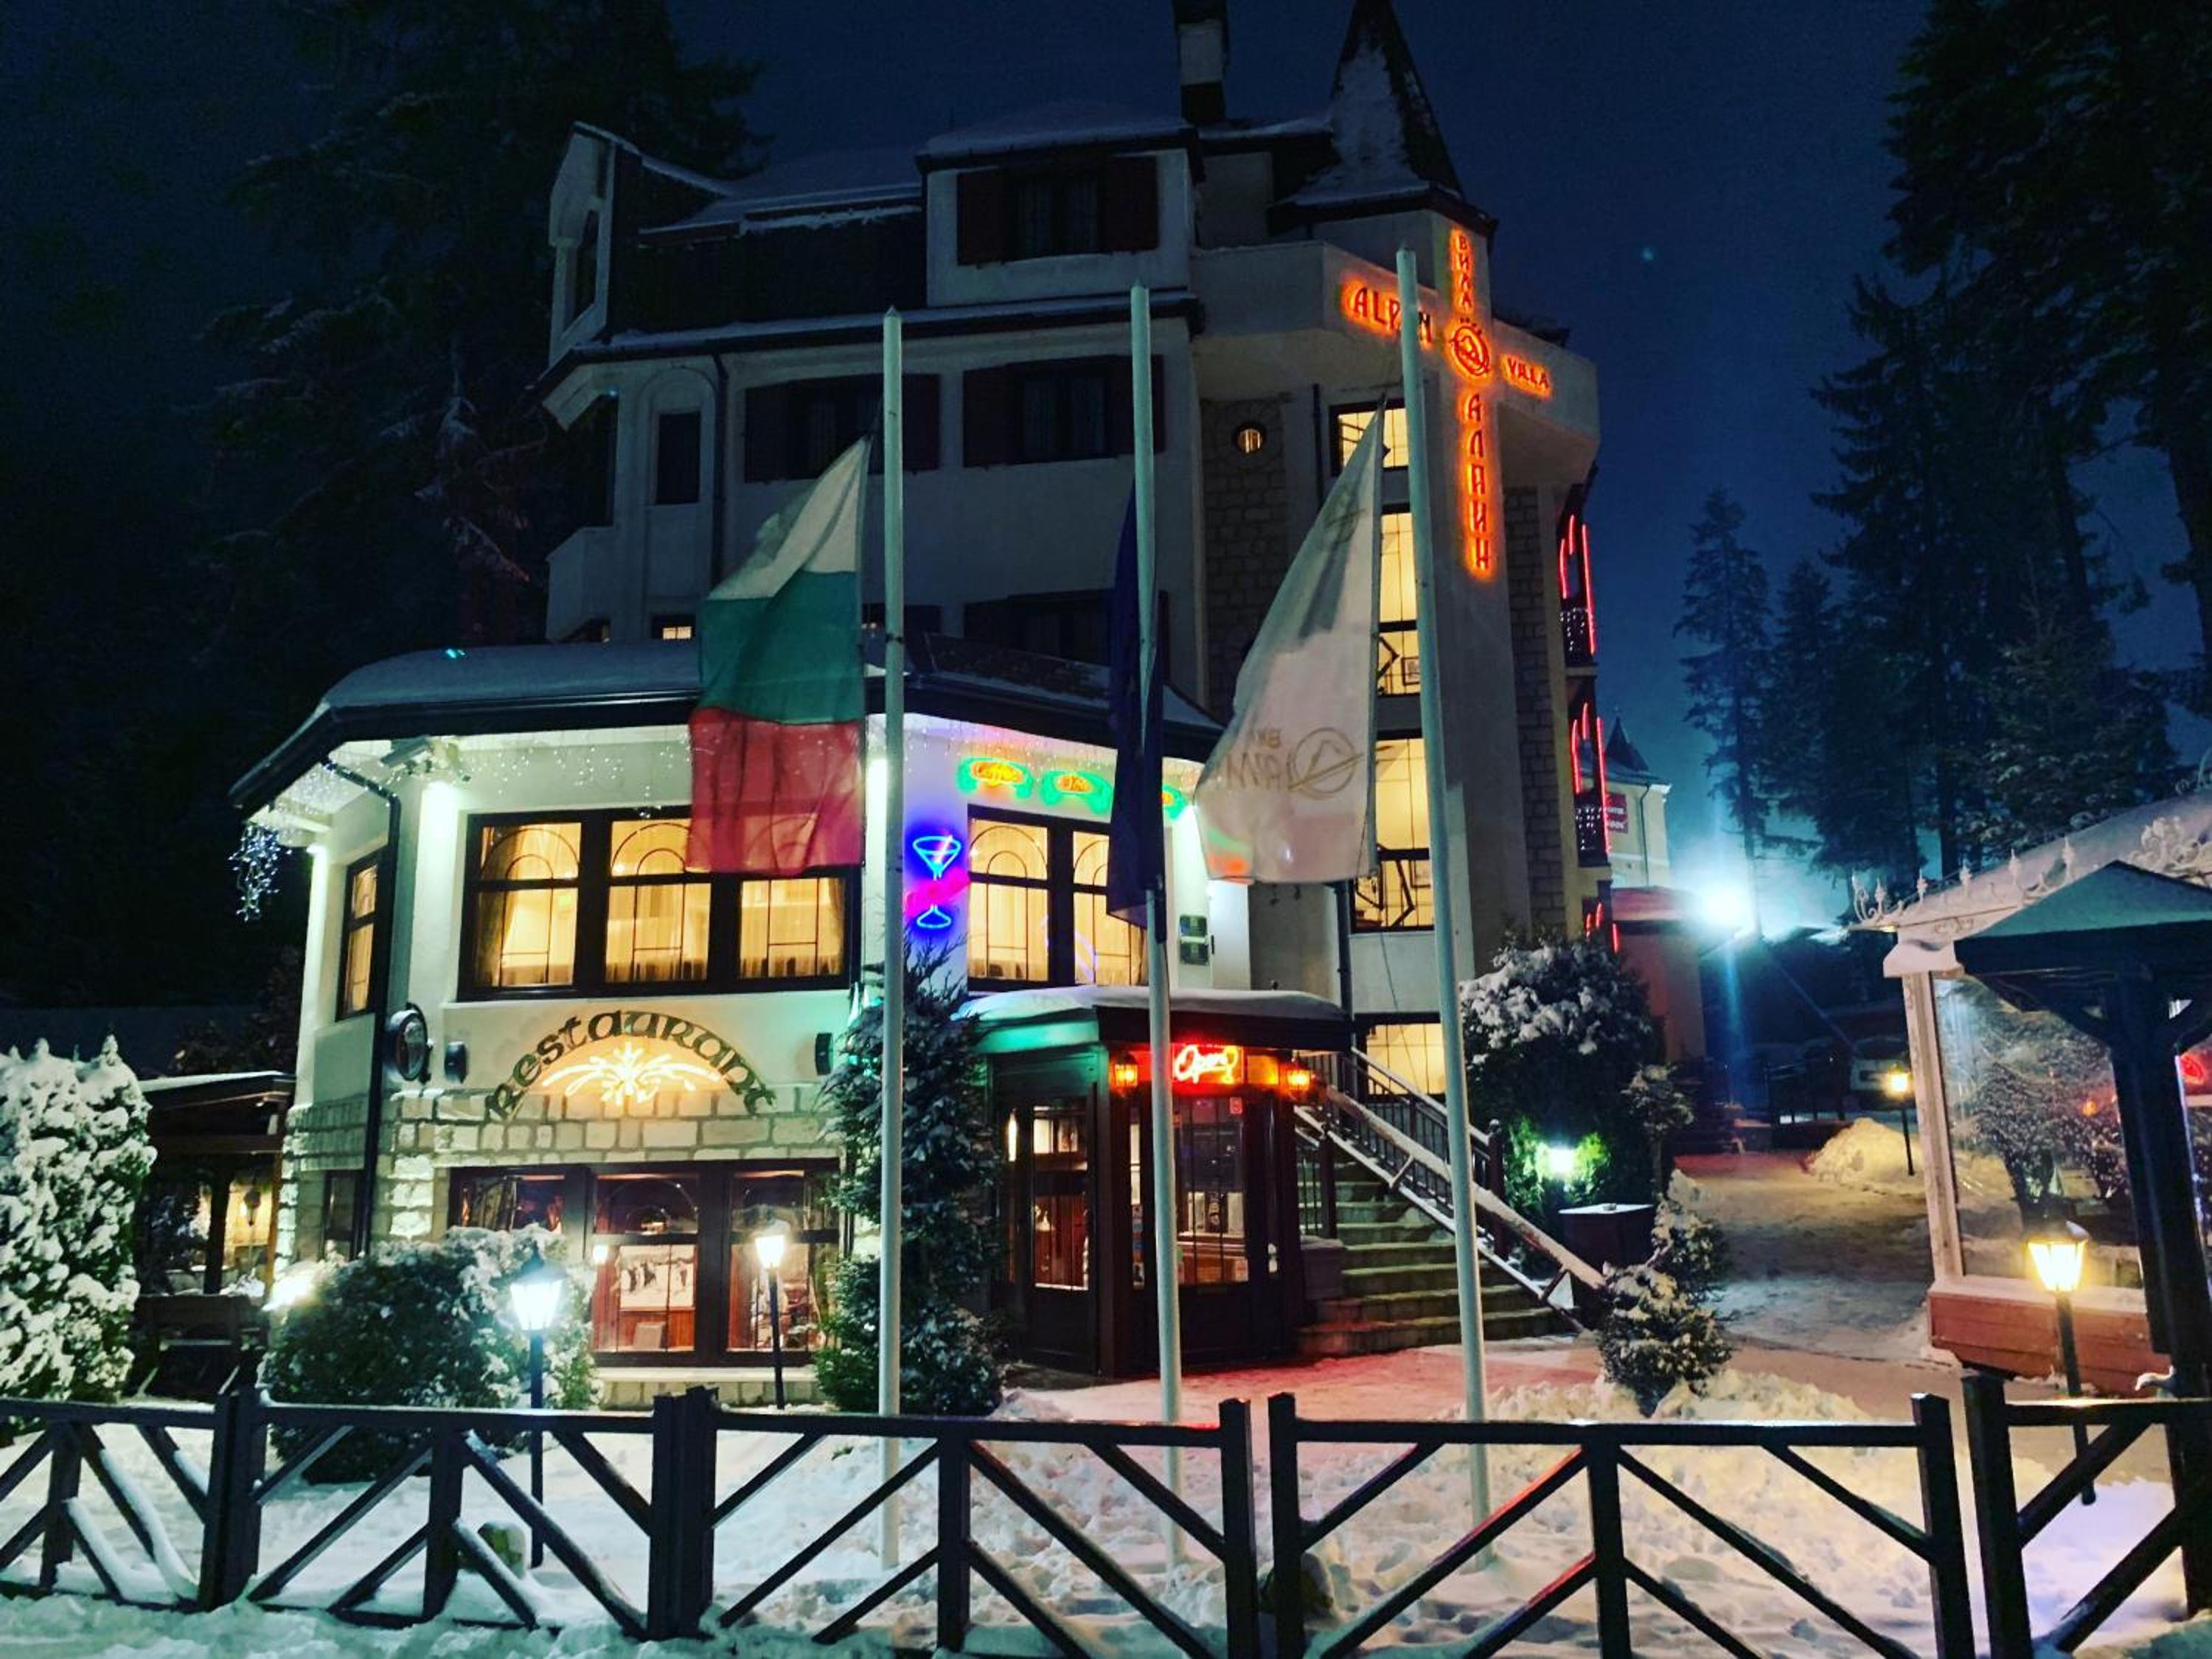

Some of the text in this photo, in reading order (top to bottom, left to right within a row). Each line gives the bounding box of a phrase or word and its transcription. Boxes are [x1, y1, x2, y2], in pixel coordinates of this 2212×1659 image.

[1353, 288, 1549, 389] ALPN VILLA
[1468, 393, 1489, 570] АЛПИН
